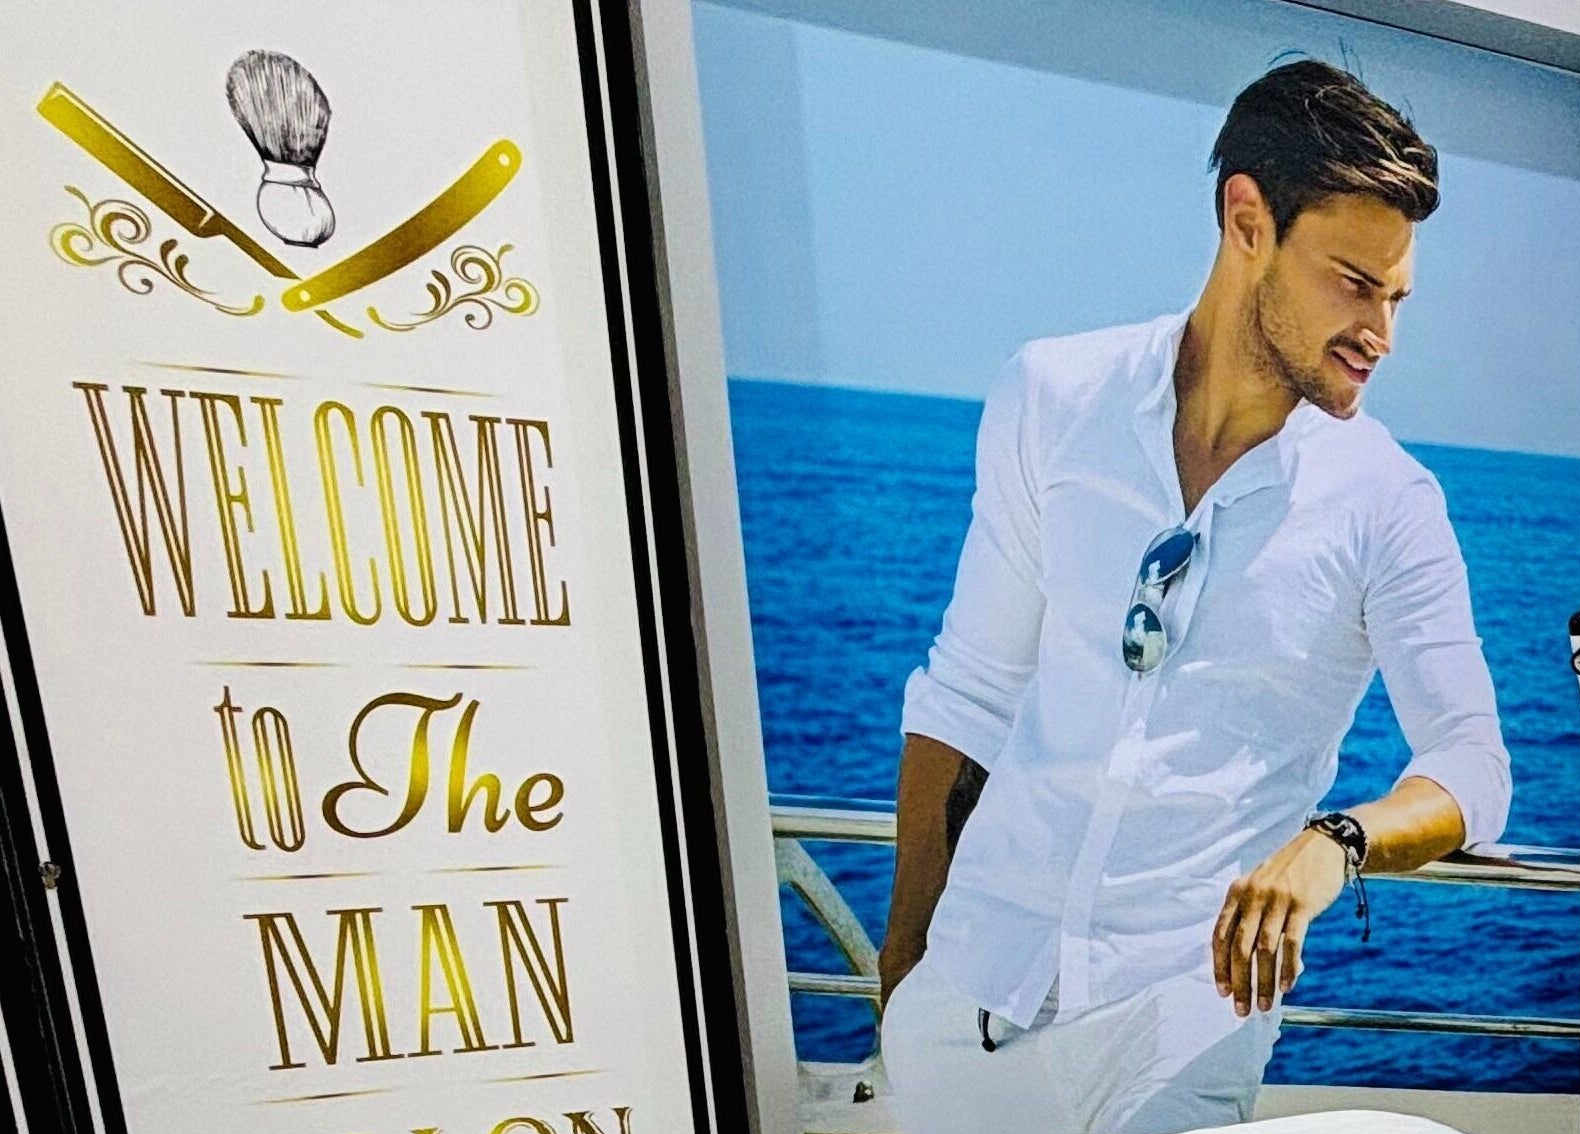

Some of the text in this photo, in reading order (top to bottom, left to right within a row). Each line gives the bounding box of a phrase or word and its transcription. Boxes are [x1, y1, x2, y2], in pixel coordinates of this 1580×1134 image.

[72, 381, 571, 627] WELCOME
[213, 685, 565, 853] to The
[242, 897, 576, 1071] MAN
